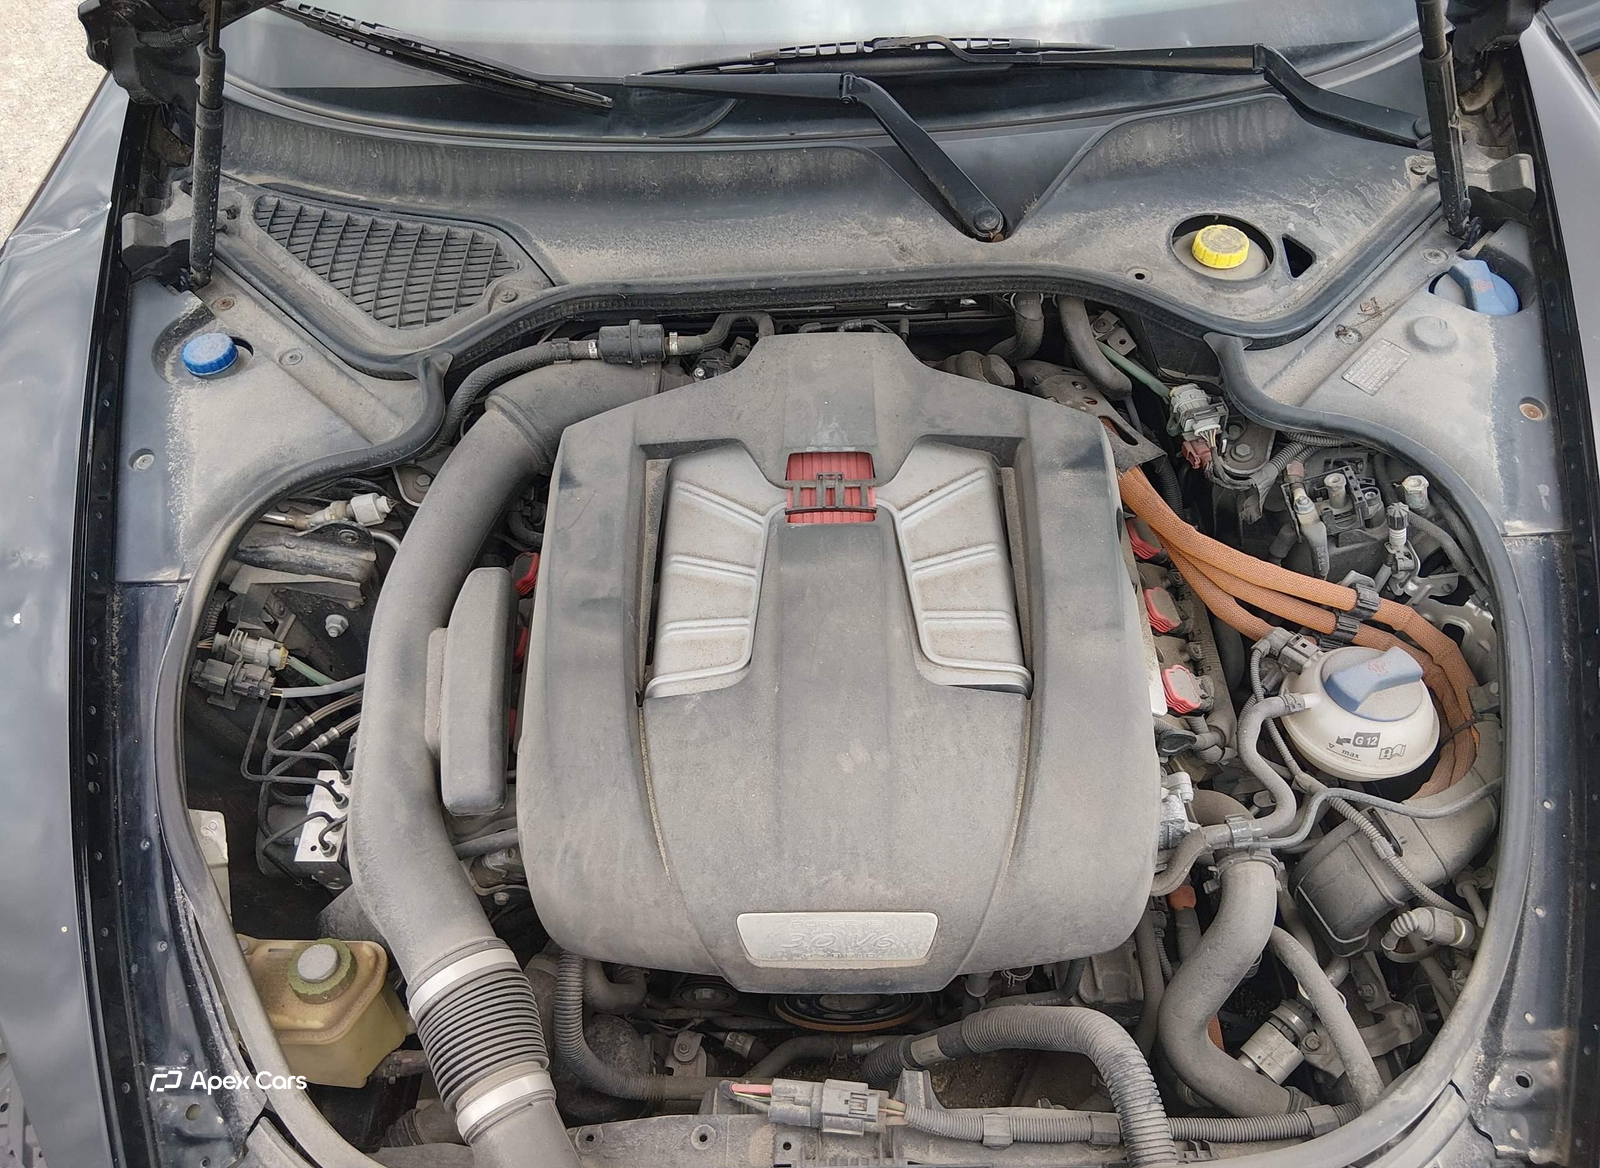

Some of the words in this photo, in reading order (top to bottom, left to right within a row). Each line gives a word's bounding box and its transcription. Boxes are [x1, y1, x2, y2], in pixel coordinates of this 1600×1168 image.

[1355, 736, 1364, 745] G
[1366, 736, 1378, 745] 12
[1341, 749, 1360, 759] max
[854, 932, 896, 948] V6
